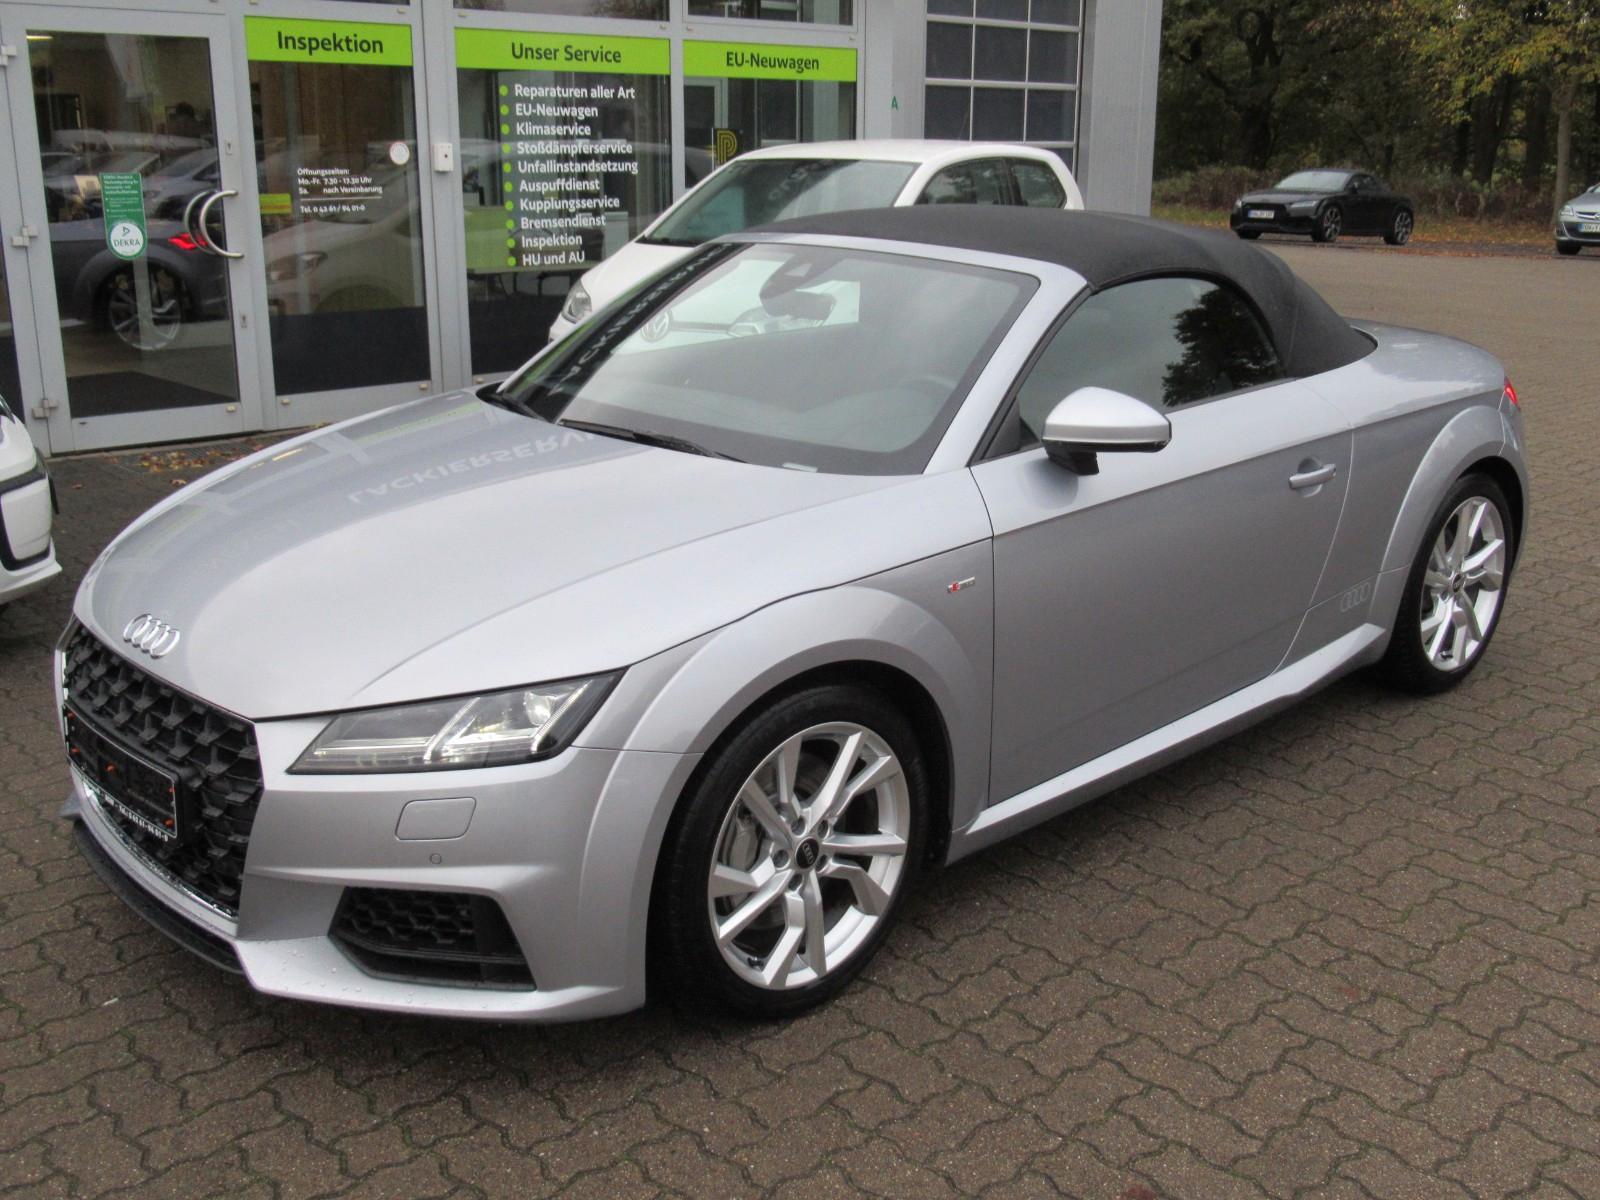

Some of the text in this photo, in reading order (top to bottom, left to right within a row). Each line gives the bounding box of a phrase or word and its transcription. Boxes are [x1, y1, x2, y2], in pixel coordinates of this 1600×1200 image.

[277, 31, 384, 56] Inspektion
[511, 42, 622, 63] Unser Service
[726, 51, 819, 74] EU-Neuwagen
[514, 84, 635, 100] Reparaturen aller Art
[515, 103, 598, 119] EU-Neuwagen
[516, 122, 591, 135] Klimaservice
[517, 140, 633, 157] Stoßdämpferservice
[518, 159, 638, 174] Unfallinstandsetzung
[519, 178, 600, 193] Auspuffdienst
[520, 195, 620, 212] Kupplungsservice
[521, 214, 606, 229] Bremsendienst
[114, 239, 141, 247] DEKRA
[521, 233, 583, 249] Inspektion
[522, 251, 585, 266] HU und AU
